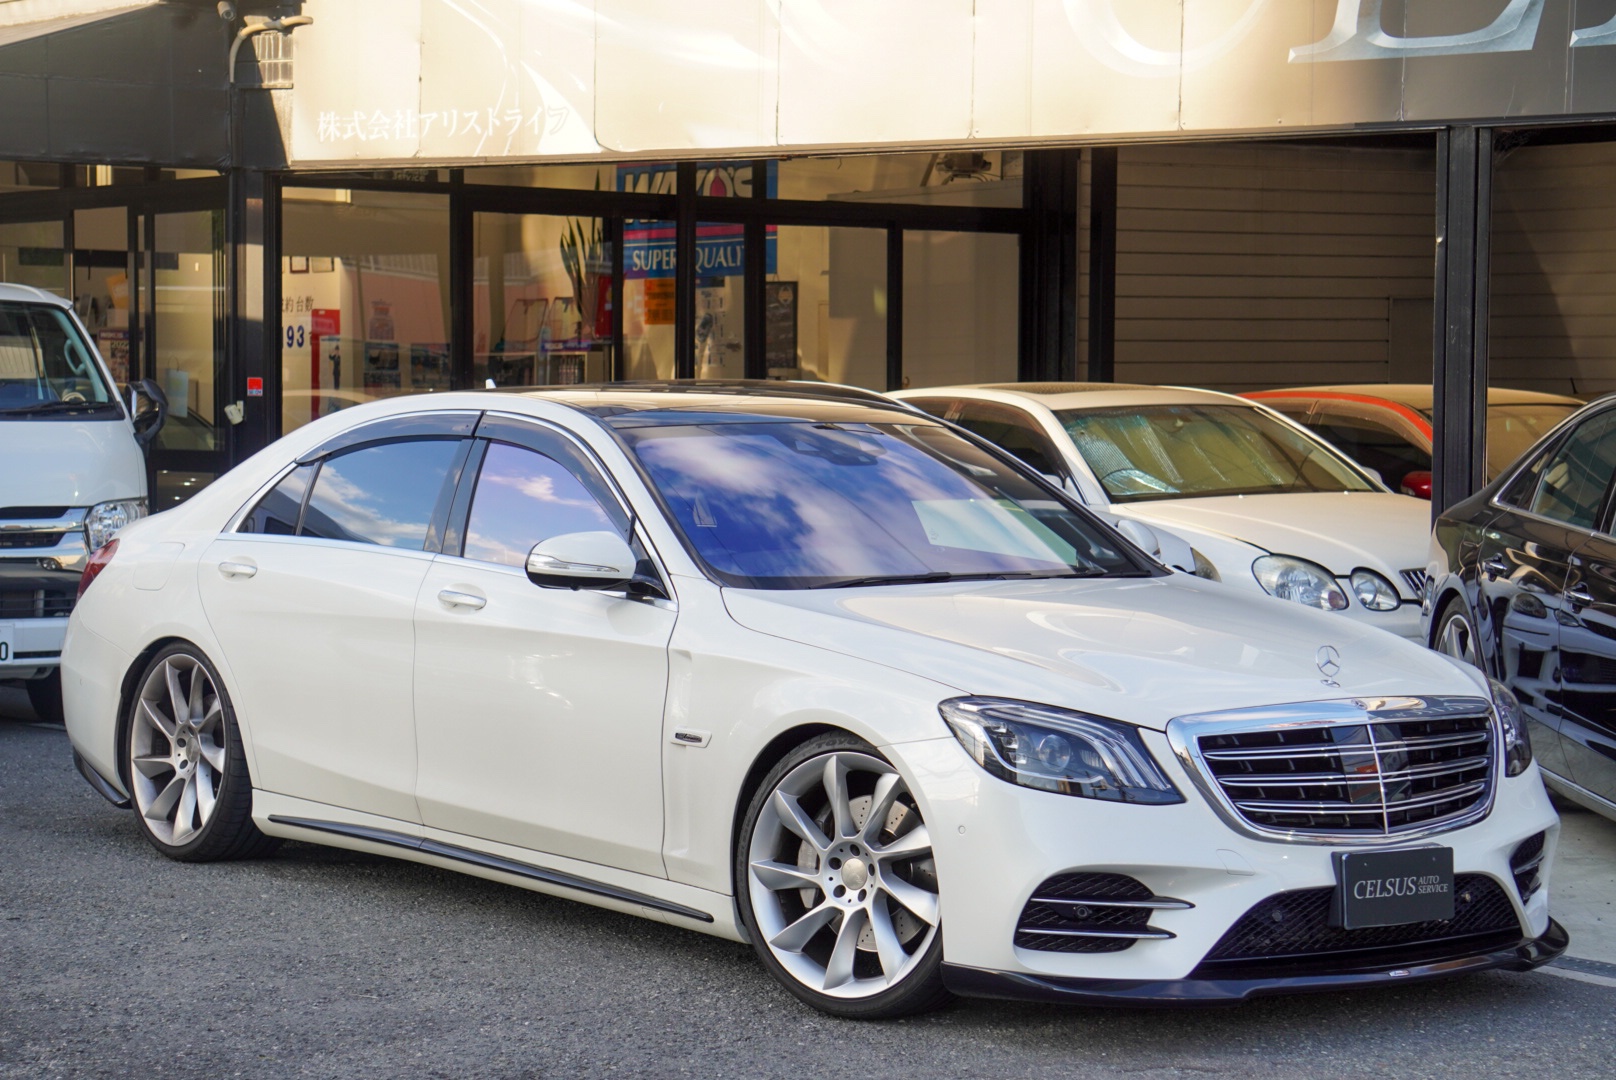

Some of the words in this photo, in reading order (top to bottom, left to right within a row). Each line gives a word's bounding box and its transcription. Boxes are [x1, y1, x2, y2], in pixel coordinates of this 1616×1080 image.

[317, 107, 570, 143] 株式会社アリストライフ
[1353, 876, 1417, 900] CELSUS
[1418, 875, 1440, 885] AUTO
[1418, 883, 1449, 894] SERVICE
